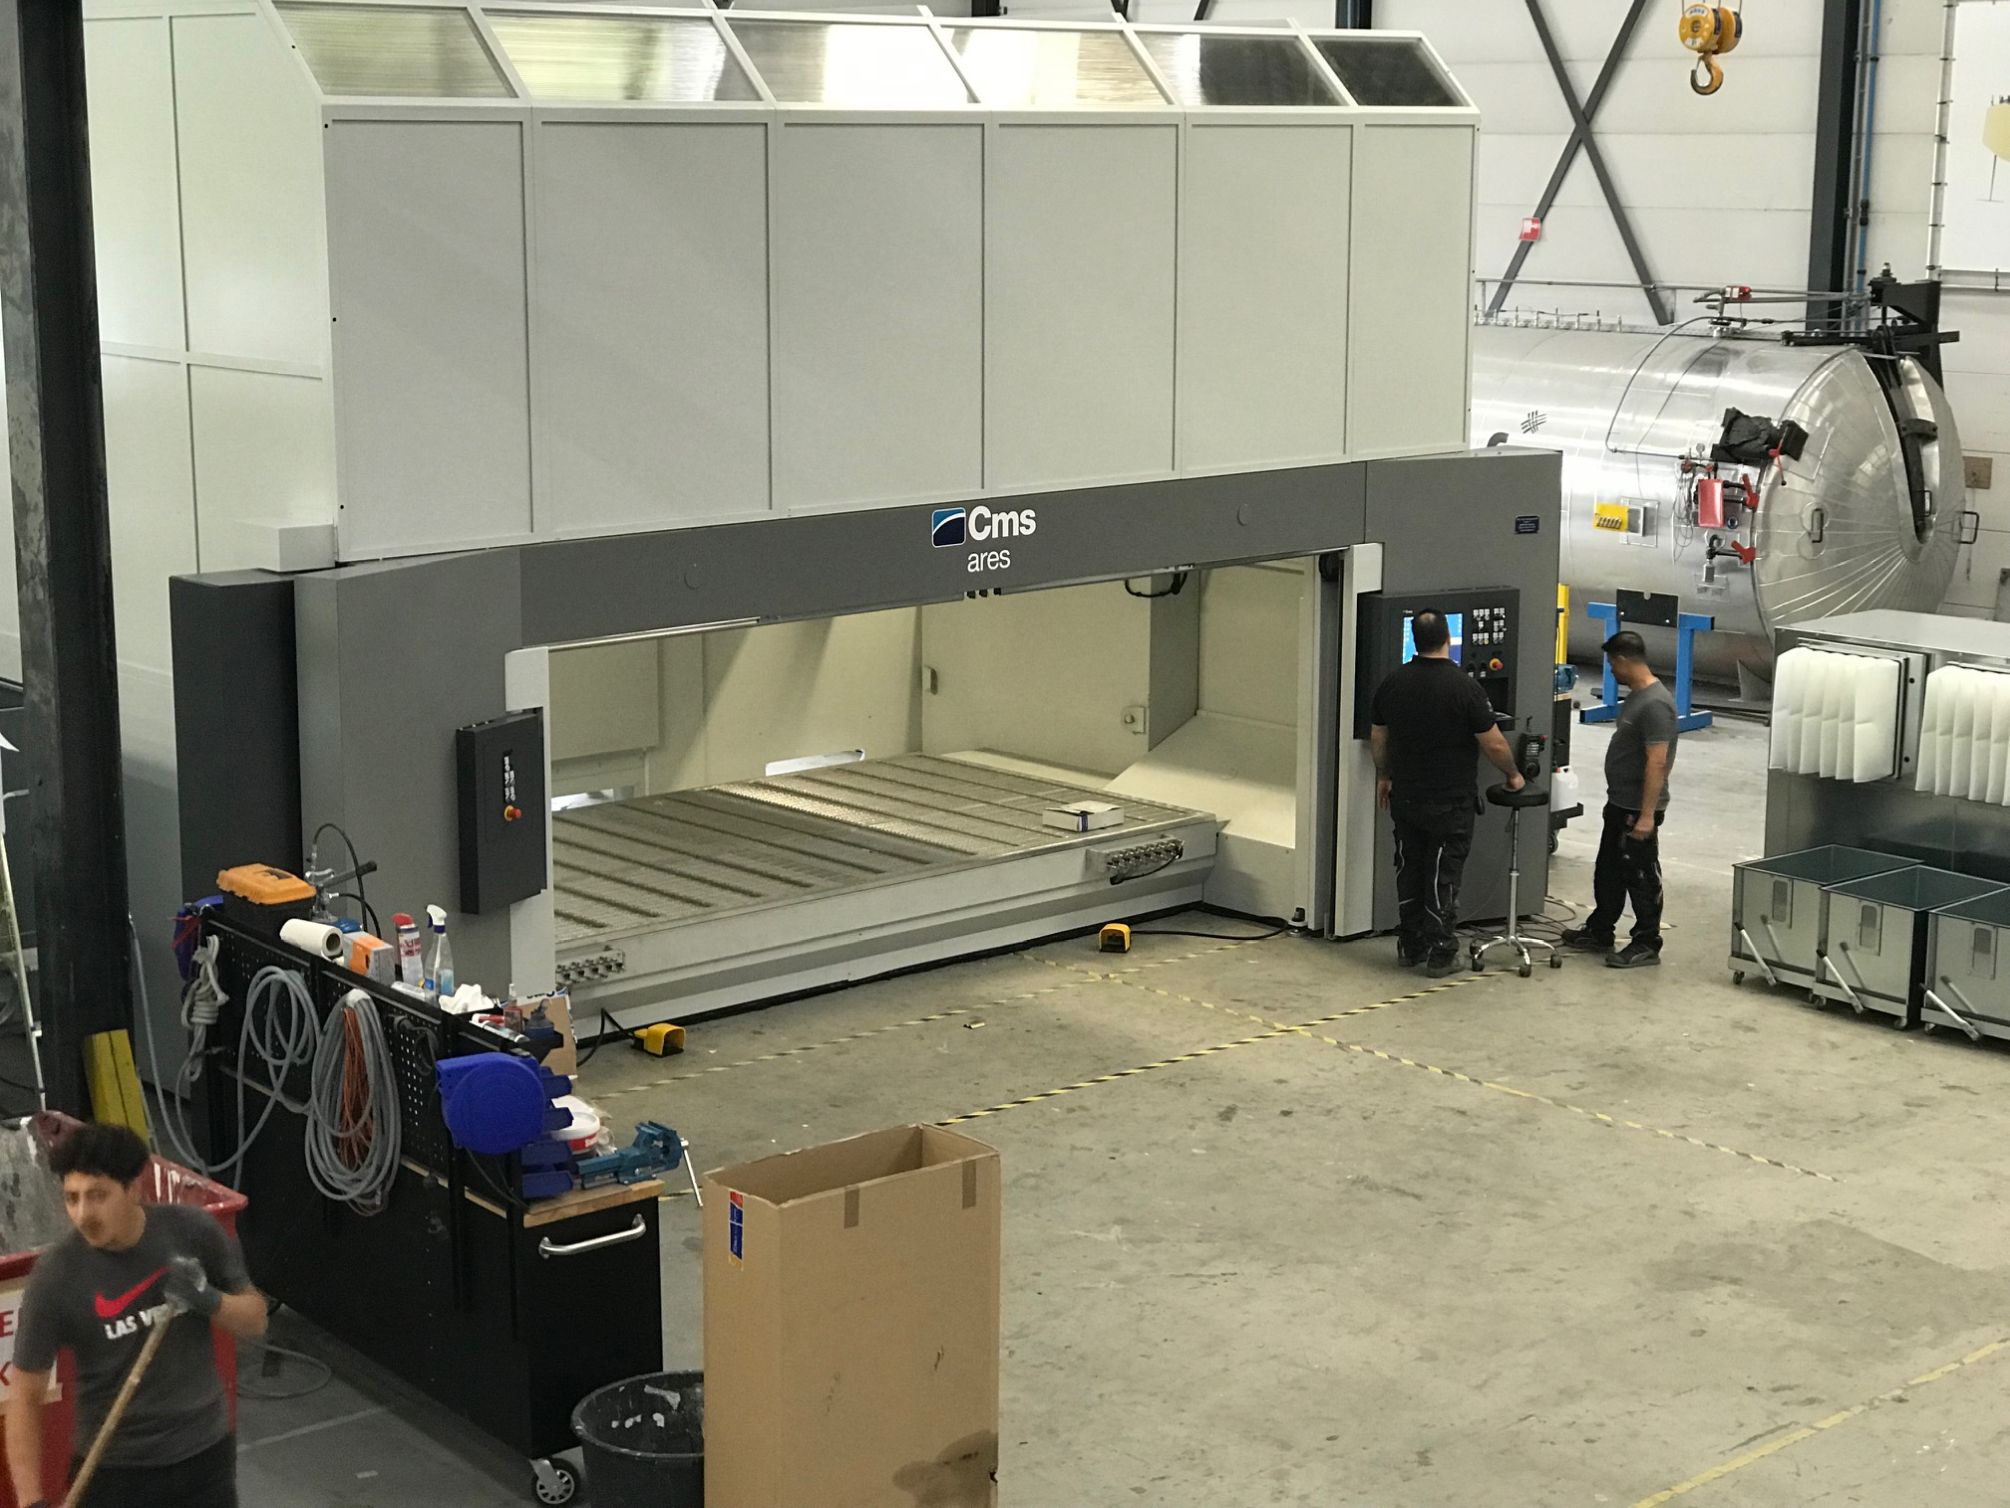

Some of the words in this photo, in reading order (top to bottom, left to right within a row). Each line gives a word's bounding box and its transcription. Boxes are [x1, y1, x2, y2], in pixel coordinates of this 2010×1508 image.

[968, 505, 1037, 541] Cms
[967, 549, 1011, 573] ares
[104, 1316, 139, 1340] LAS
